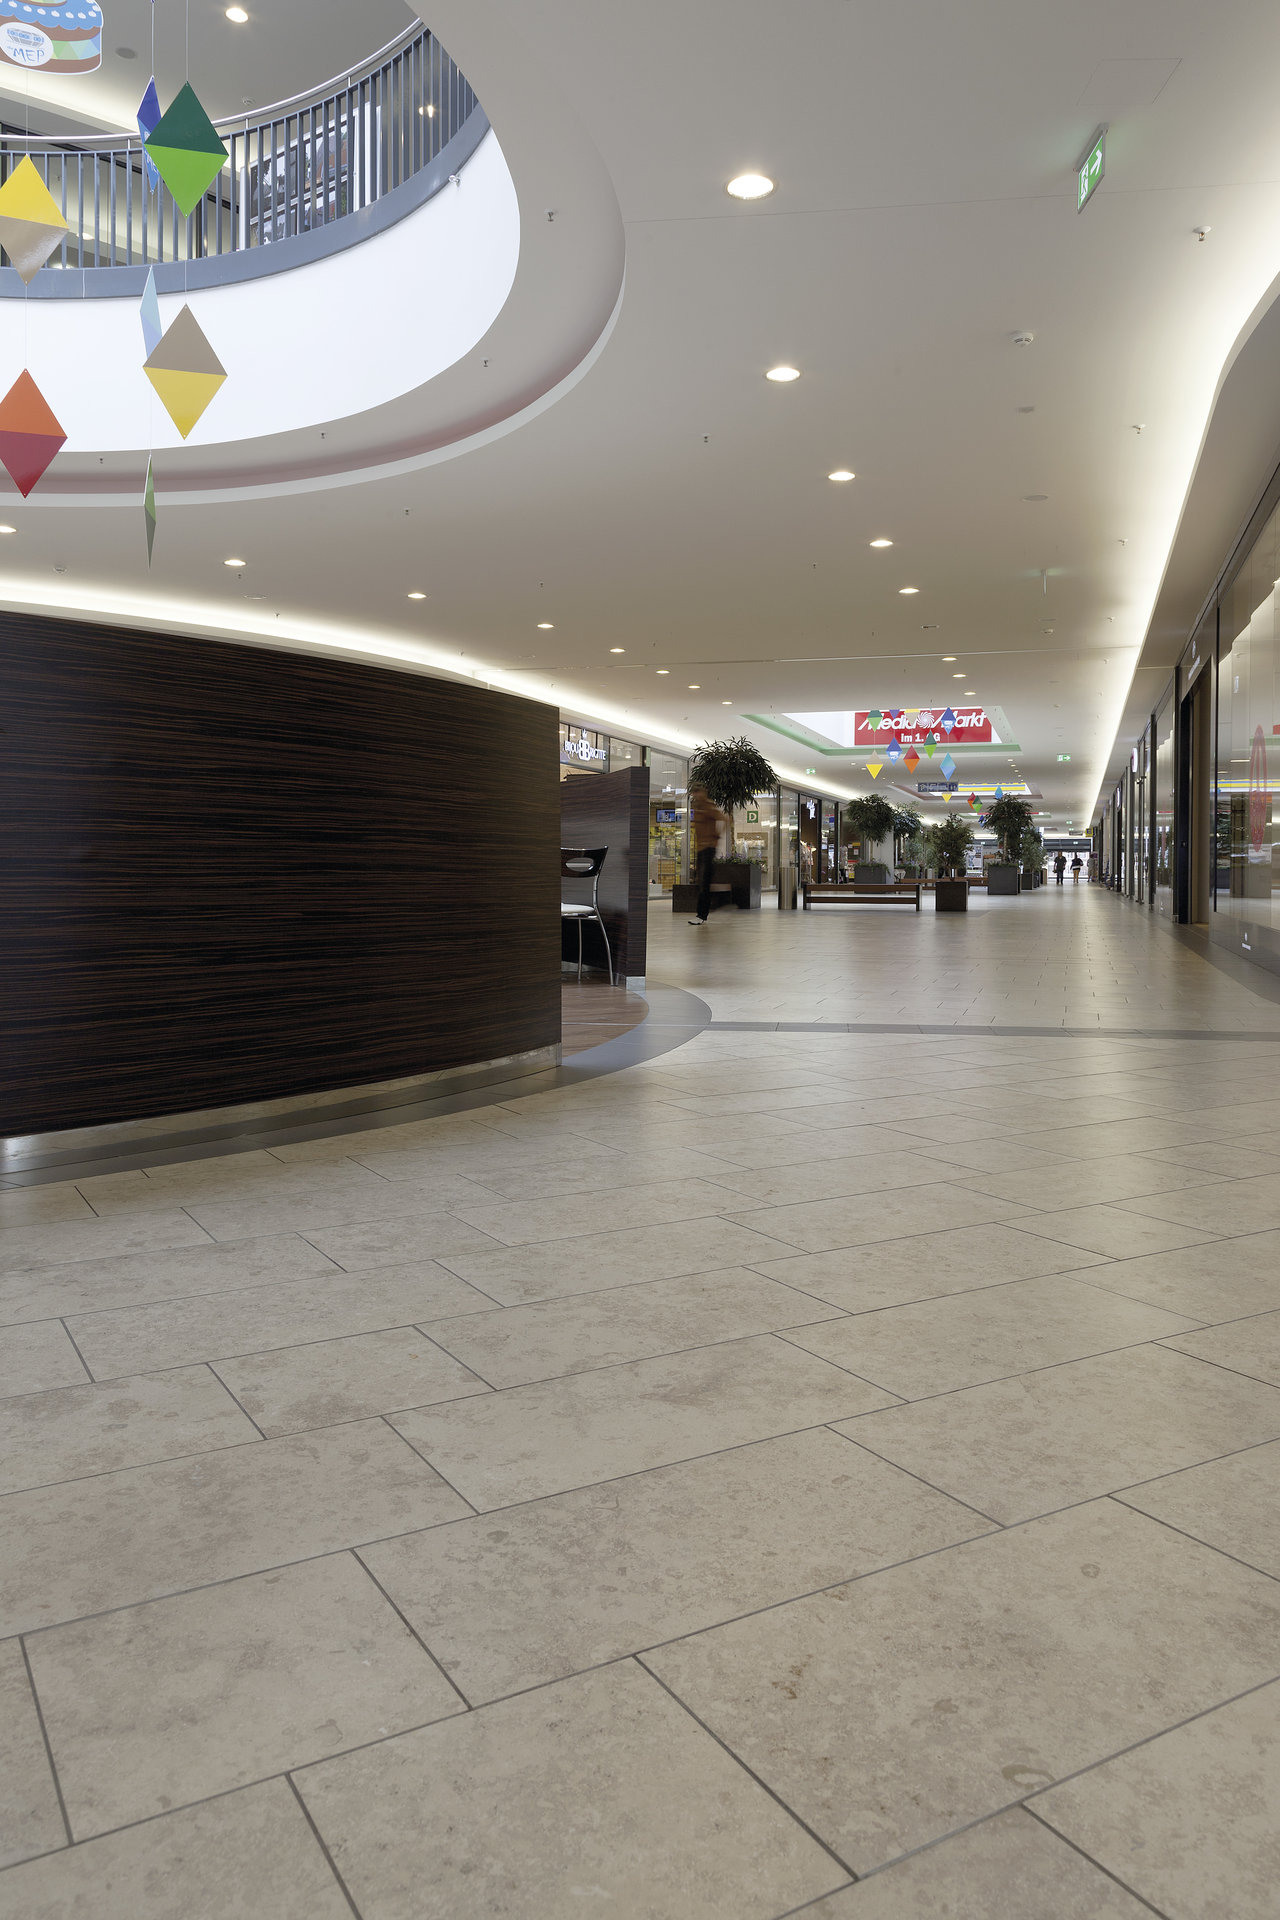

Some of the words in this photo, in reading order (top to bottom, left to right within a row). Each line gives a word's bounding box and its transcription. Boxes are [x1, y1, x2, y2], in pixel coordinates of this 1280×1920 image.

[13, 48, 45, 62] MEP
[901, 733, 913, 742] im
[914, 733, 924, 742] 1.
[749, 812, 757, 821] D
